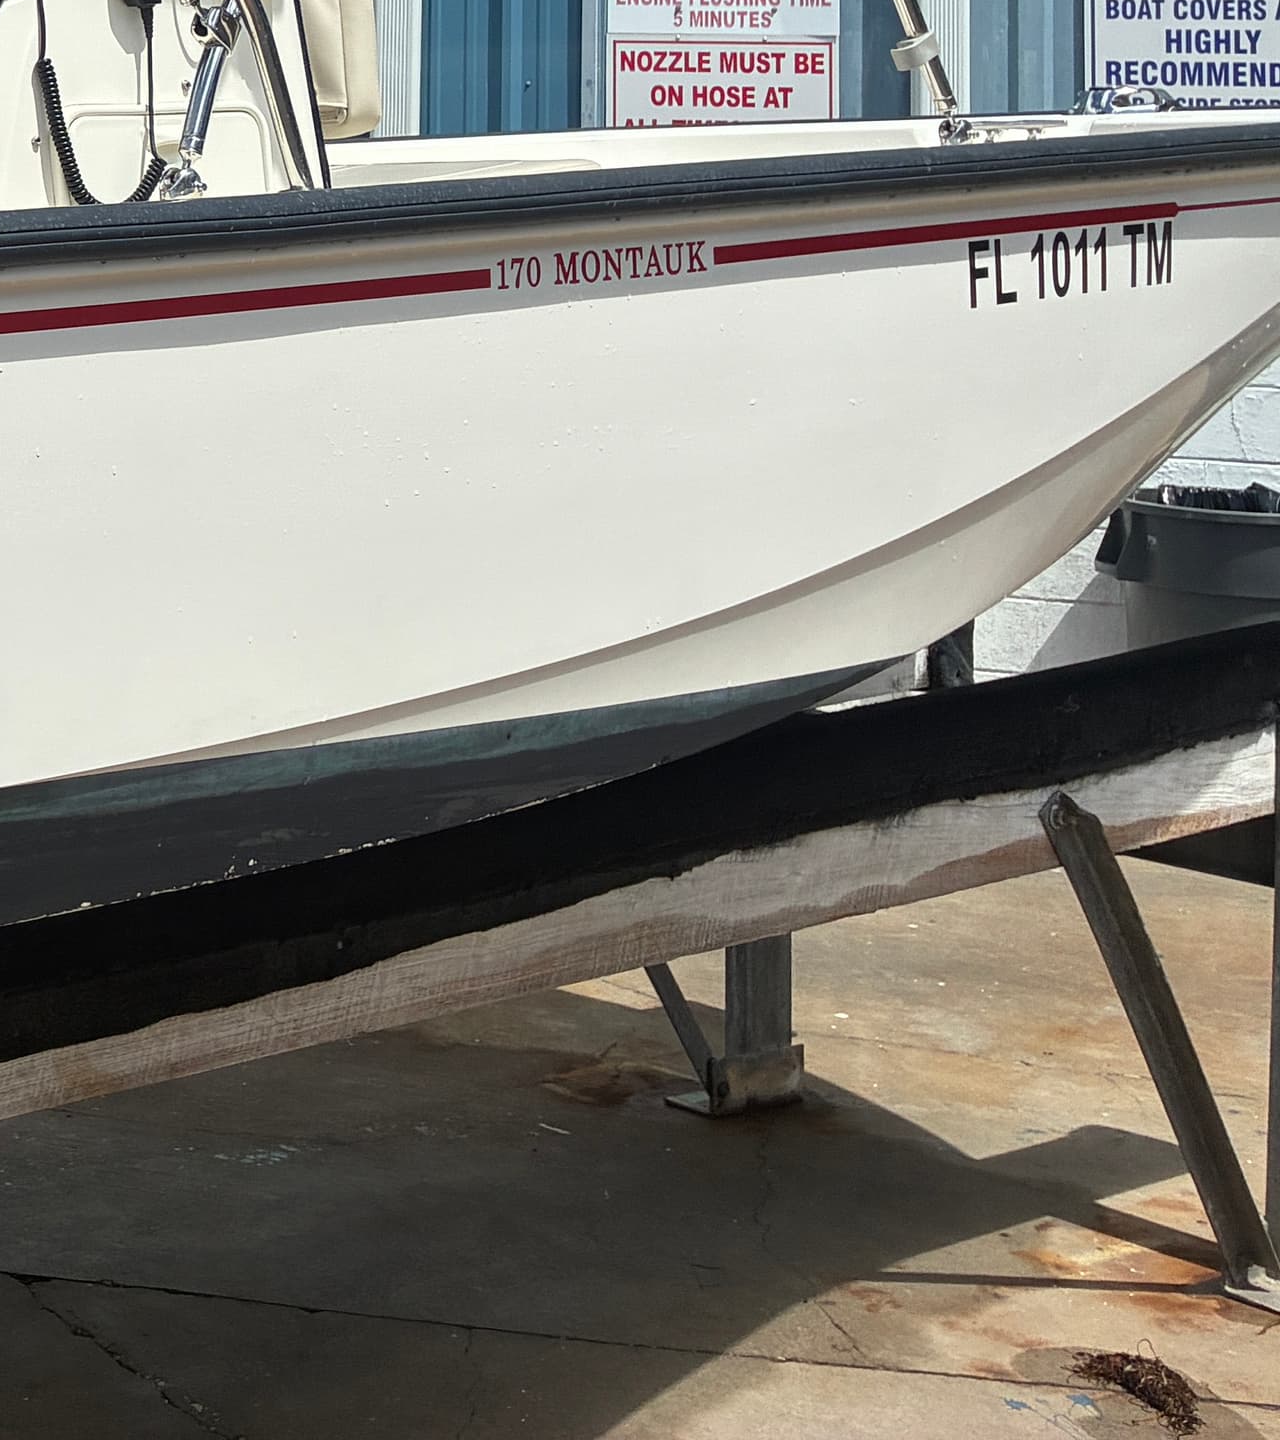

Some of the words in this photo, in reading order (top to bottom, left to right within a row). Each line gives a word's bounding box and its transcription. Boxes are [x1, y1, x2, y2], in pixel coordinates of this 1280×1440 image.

[673, 11, 683, 27] 5
[690, 11, 772, 28] MINUTES
[1173, 0, 1267, 21] COVERS
[1165, 29, 1262, 54] HIGHLY
[620, 50, 711, 73] NOZZLE
[719, 52, 786, 74] MUST
[794, 53, 825, 74] BE
[1105, 60, 1280, 88] RECOMMEND
[650, 85, 683, 107] ON
[692, 86, 756, 108] HOSE
[763, 87, 793, 109] AT
[497, 256, 541, 290] 170
[554, 241, 708, 285] MONTAUK
[968, 238, 1018, 309] FL
[1031, 226, 1107, 299] 1011
[1123, 220, 1173, 288] TM
